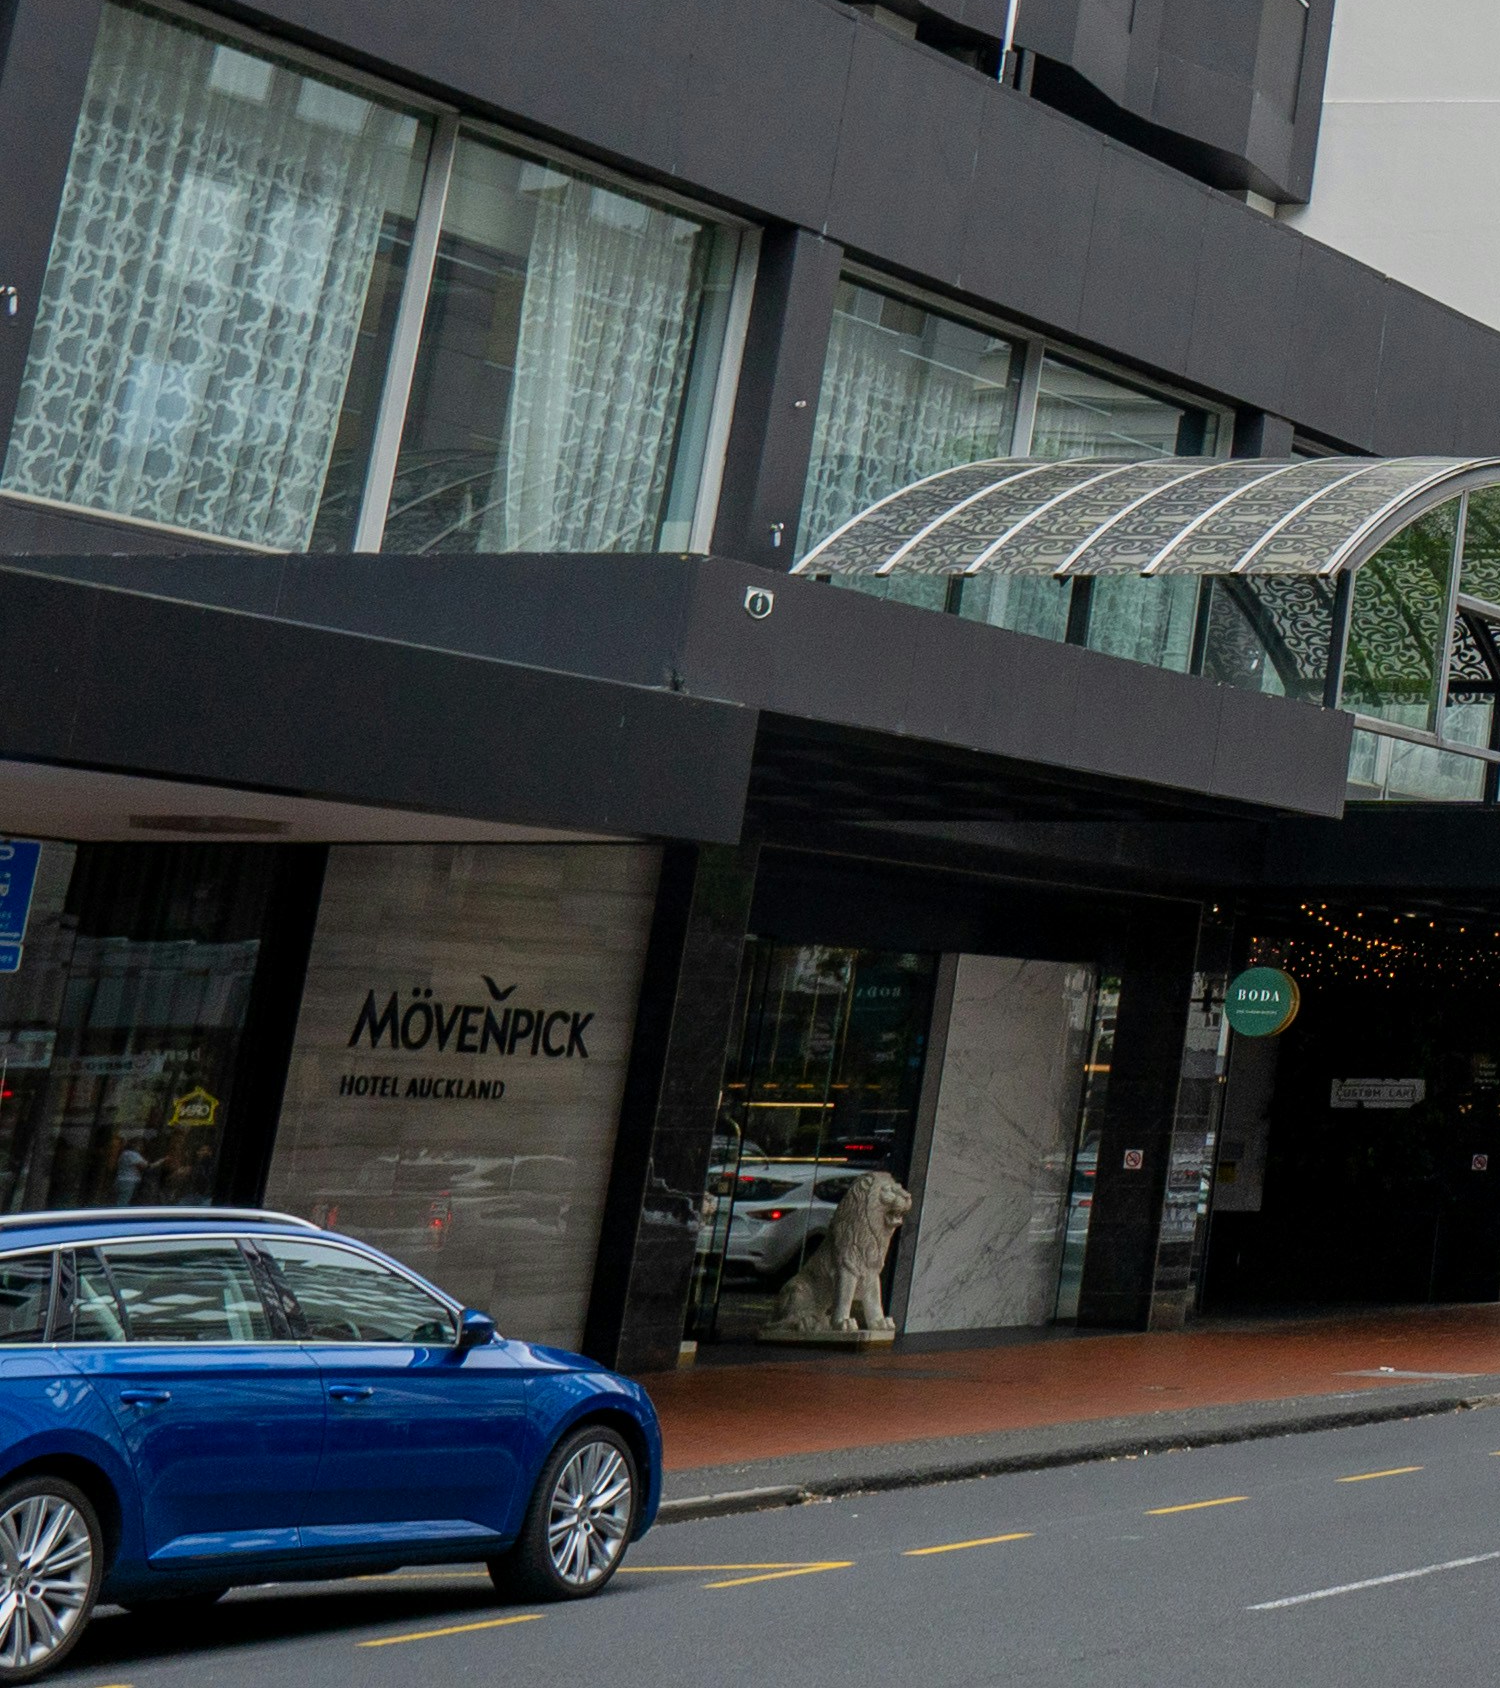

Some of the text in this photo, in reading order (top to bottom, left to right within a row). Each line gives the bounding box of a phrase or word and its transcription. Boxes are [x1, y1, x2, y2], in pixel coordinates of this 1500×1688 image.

[1237, 988, 1280, 1002] BODA
[347, 986, 595, 1061] MÖVENPICK
[338, 1073, 506, 1102] HOTEL AUCKLAND
